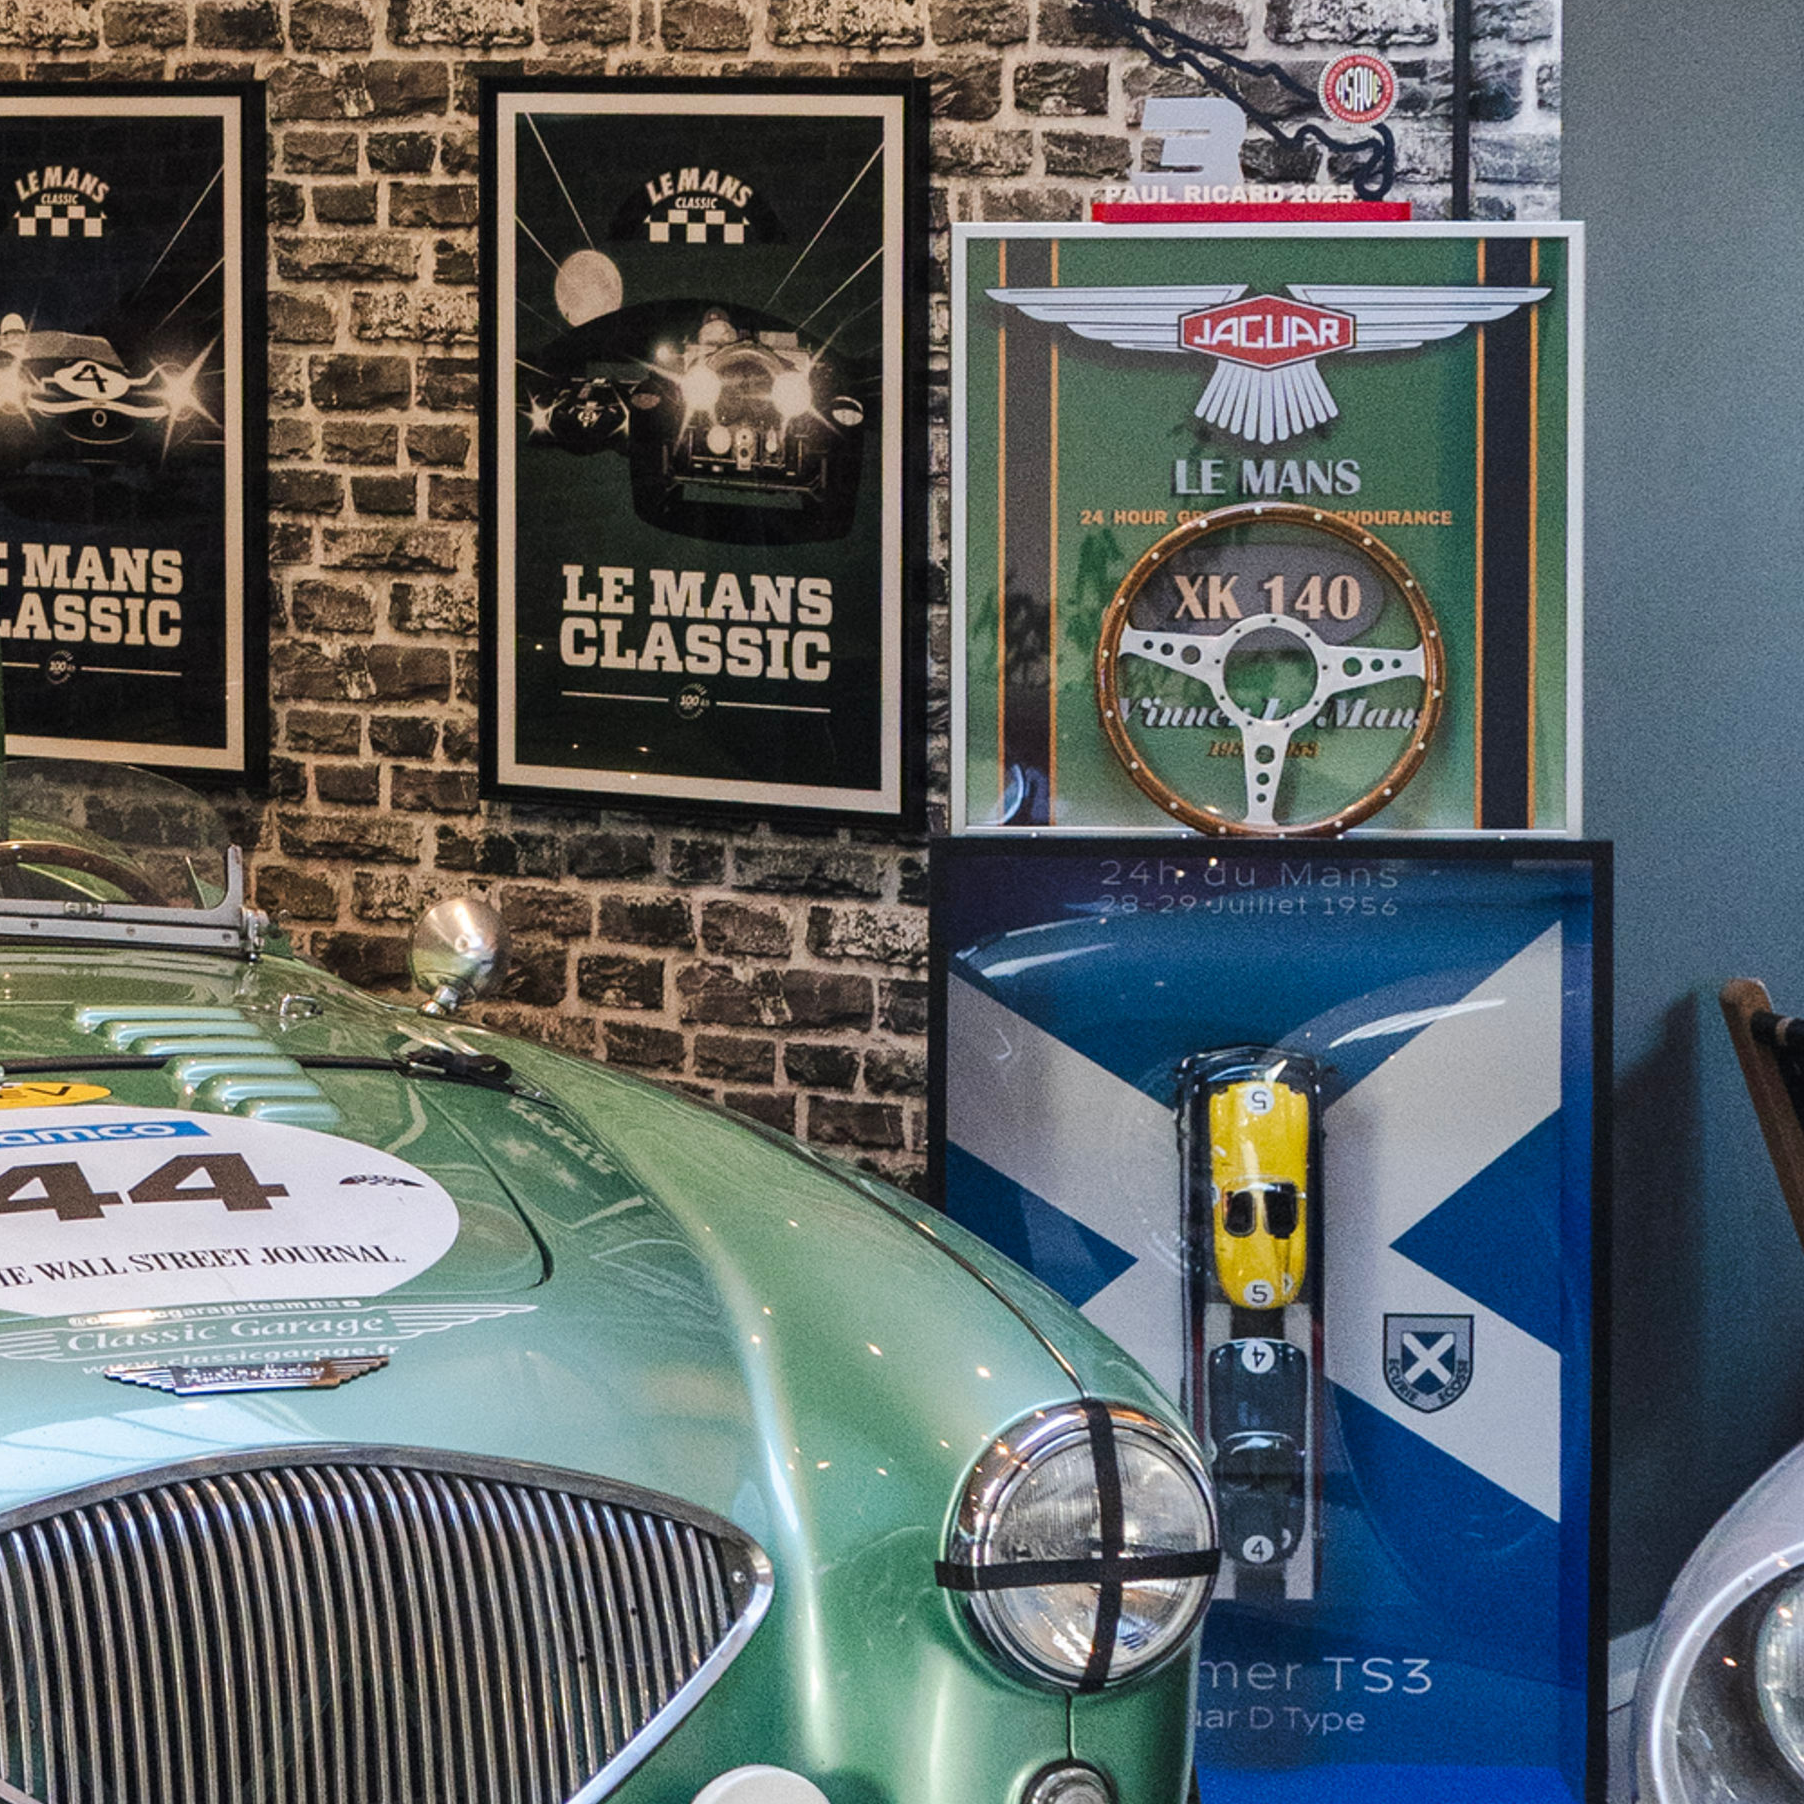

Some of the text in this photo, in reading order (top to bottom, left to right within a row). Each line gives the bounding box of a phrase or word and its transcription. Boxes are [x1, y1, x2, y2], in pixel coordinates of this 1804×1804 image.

[15, 165, 111, 204] LE MANS
[41, 193, 79, 205] CLASSIC
[645, 166, 754, 209] LE MANS
[1104, 184, 1354, 203] PAUL RICARD 2025
[675, 197, 718, 209] CLASSIC
[1193, 315, 1340, 349] JAGUAR
[71, 364, 109, 393] 4
[1174, 459, 1362, 495] LE MANS
[1080, 510, 1105, 526] 24
[1113, 509, 1168, 526] HOUR
[22, 543, 184, 595] MANS
[562, 564, 834, 626] LE MANS
[1174, 575, 1361, 621] XK 140
[560, 616, 831, 682] CLASSIC
[1100, 860, 1399, 888] 24h du Mans
[1099, 895, 1399, 916] 28-29 Juillet 1956
[34, 1256, 128, 1282] WALL
[128, 1247, 252, 1273] STREET
[260, 1245, 406, 1266] JOURNAL.
[1252, 1284, 1269, 1304] 5
[68, 1313, 385, 1351] Classic Garage
[1251, 1346, 1267, 1367] 4
[1250, 1540, 1265, 1562] 4
[1322, 1656, 1433, 1694] TS3
[1249, 1706, 1273, 1729] D
[1283, 1707, 1366, 1736] Type
